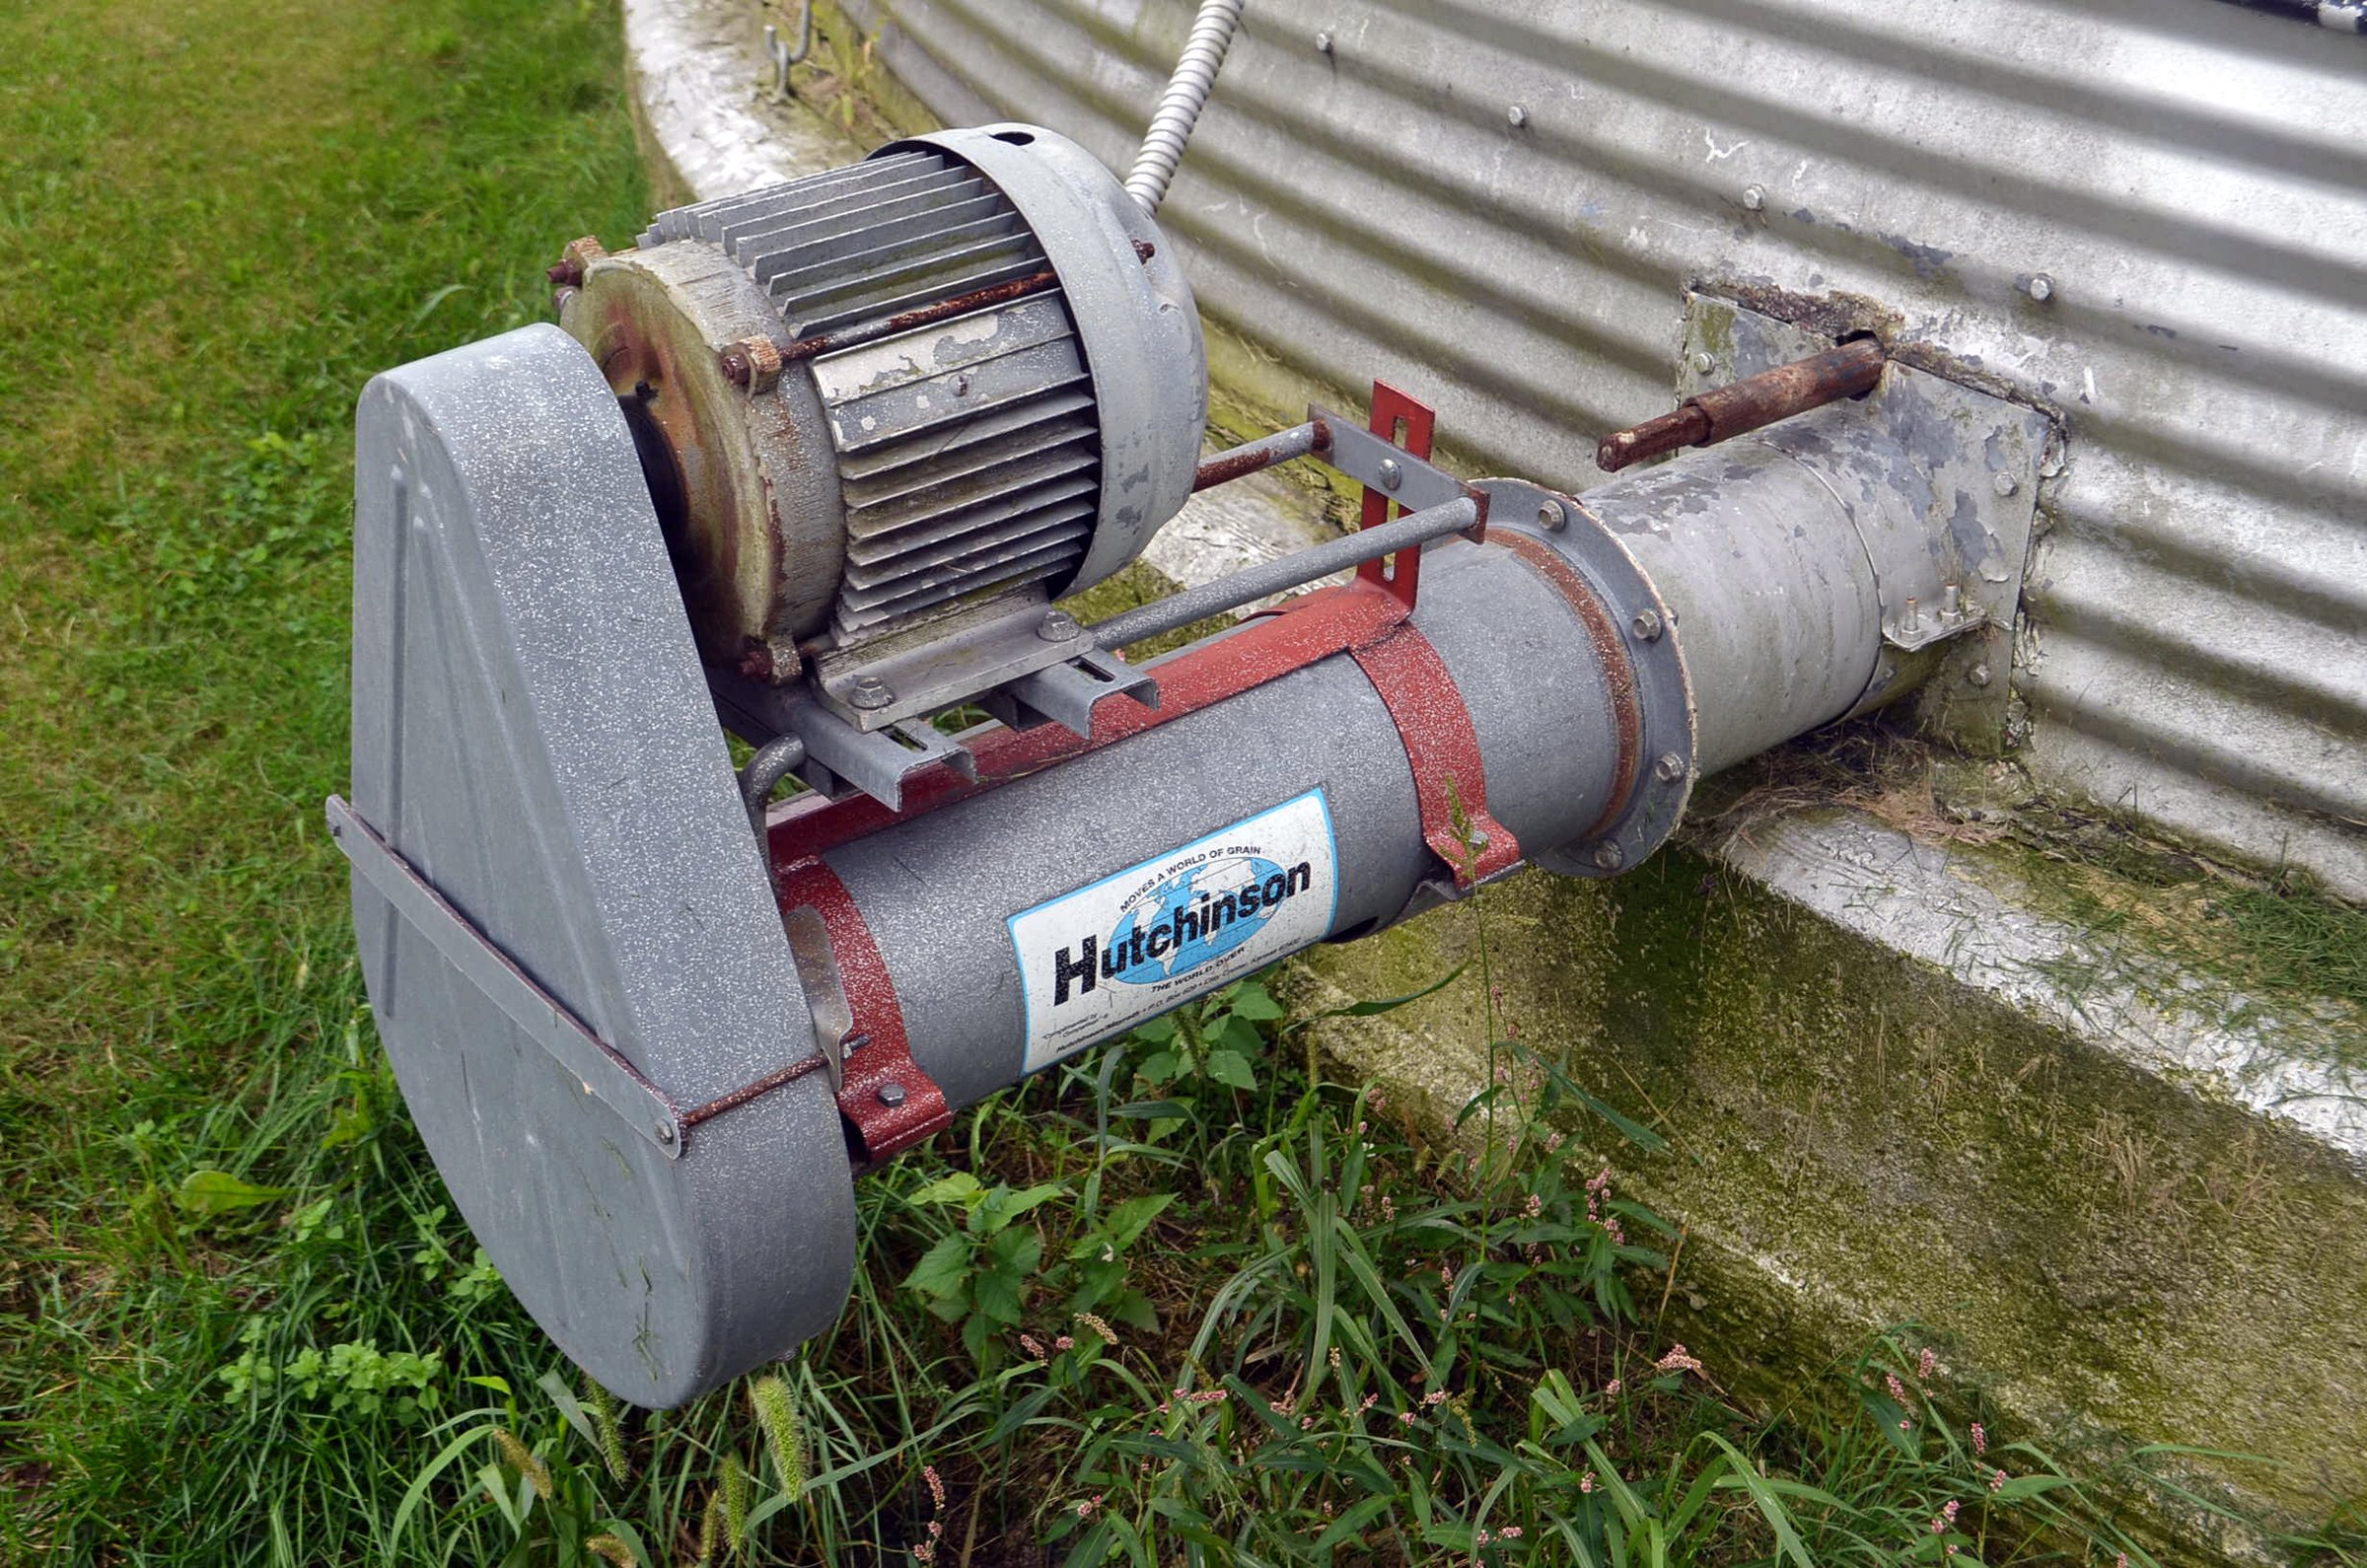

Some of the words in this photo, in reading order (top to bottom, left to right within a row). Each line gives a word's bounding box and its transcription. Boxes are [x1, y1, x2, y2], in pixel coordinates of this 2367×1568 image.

[1119, 878, 1155, 912] MOVES
[1157, 873, 1166, 883] A
[1166, 853, 1206, 875] WORLD
[1209, 847, 1224, 859] OF
[1227, 845, 1261, 855] GRAIN
[1053, 859, 1312, 1007] Hutchinson
[1150, 981, 1171, 993] THE
[1174, 964, 1213, 985] WORLD
[1215, 947, 1246, 967] OVER
